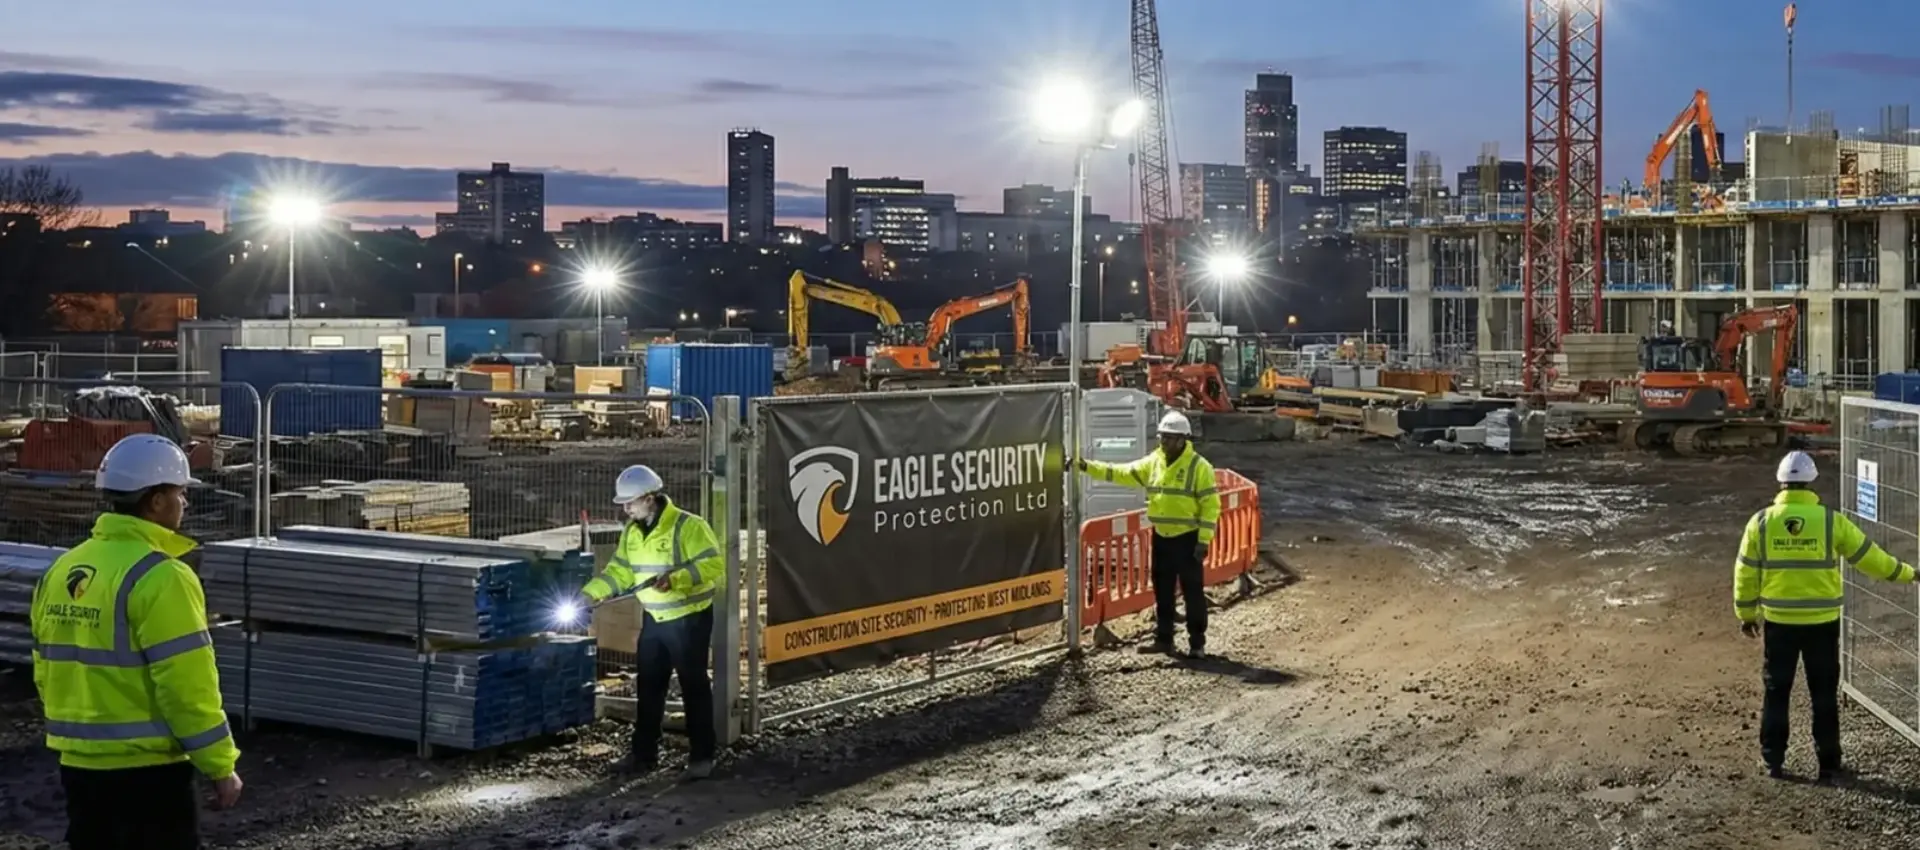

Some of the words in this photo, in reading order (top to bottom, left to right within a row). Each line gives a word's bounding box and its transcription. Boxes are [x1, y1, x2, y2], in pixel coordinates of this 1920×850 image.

[874, 453, 946, 503] EAGLE
[951, 442, 1047, 493] SECURITY
[874, 497, 1004, 533] Protection
[1015, 488, 1047, 512] Ltd
[785, 620, 860, 650] CONSTRUCTION
[861, 615, 882, 635] SITE
[884, 606, 927, 630] SECURITY
[935, 594, 986, 620] PROTECTING
[987, 589, 1010, 609] WEST
[1011, 580, 1052, 601] MIDLANDS
